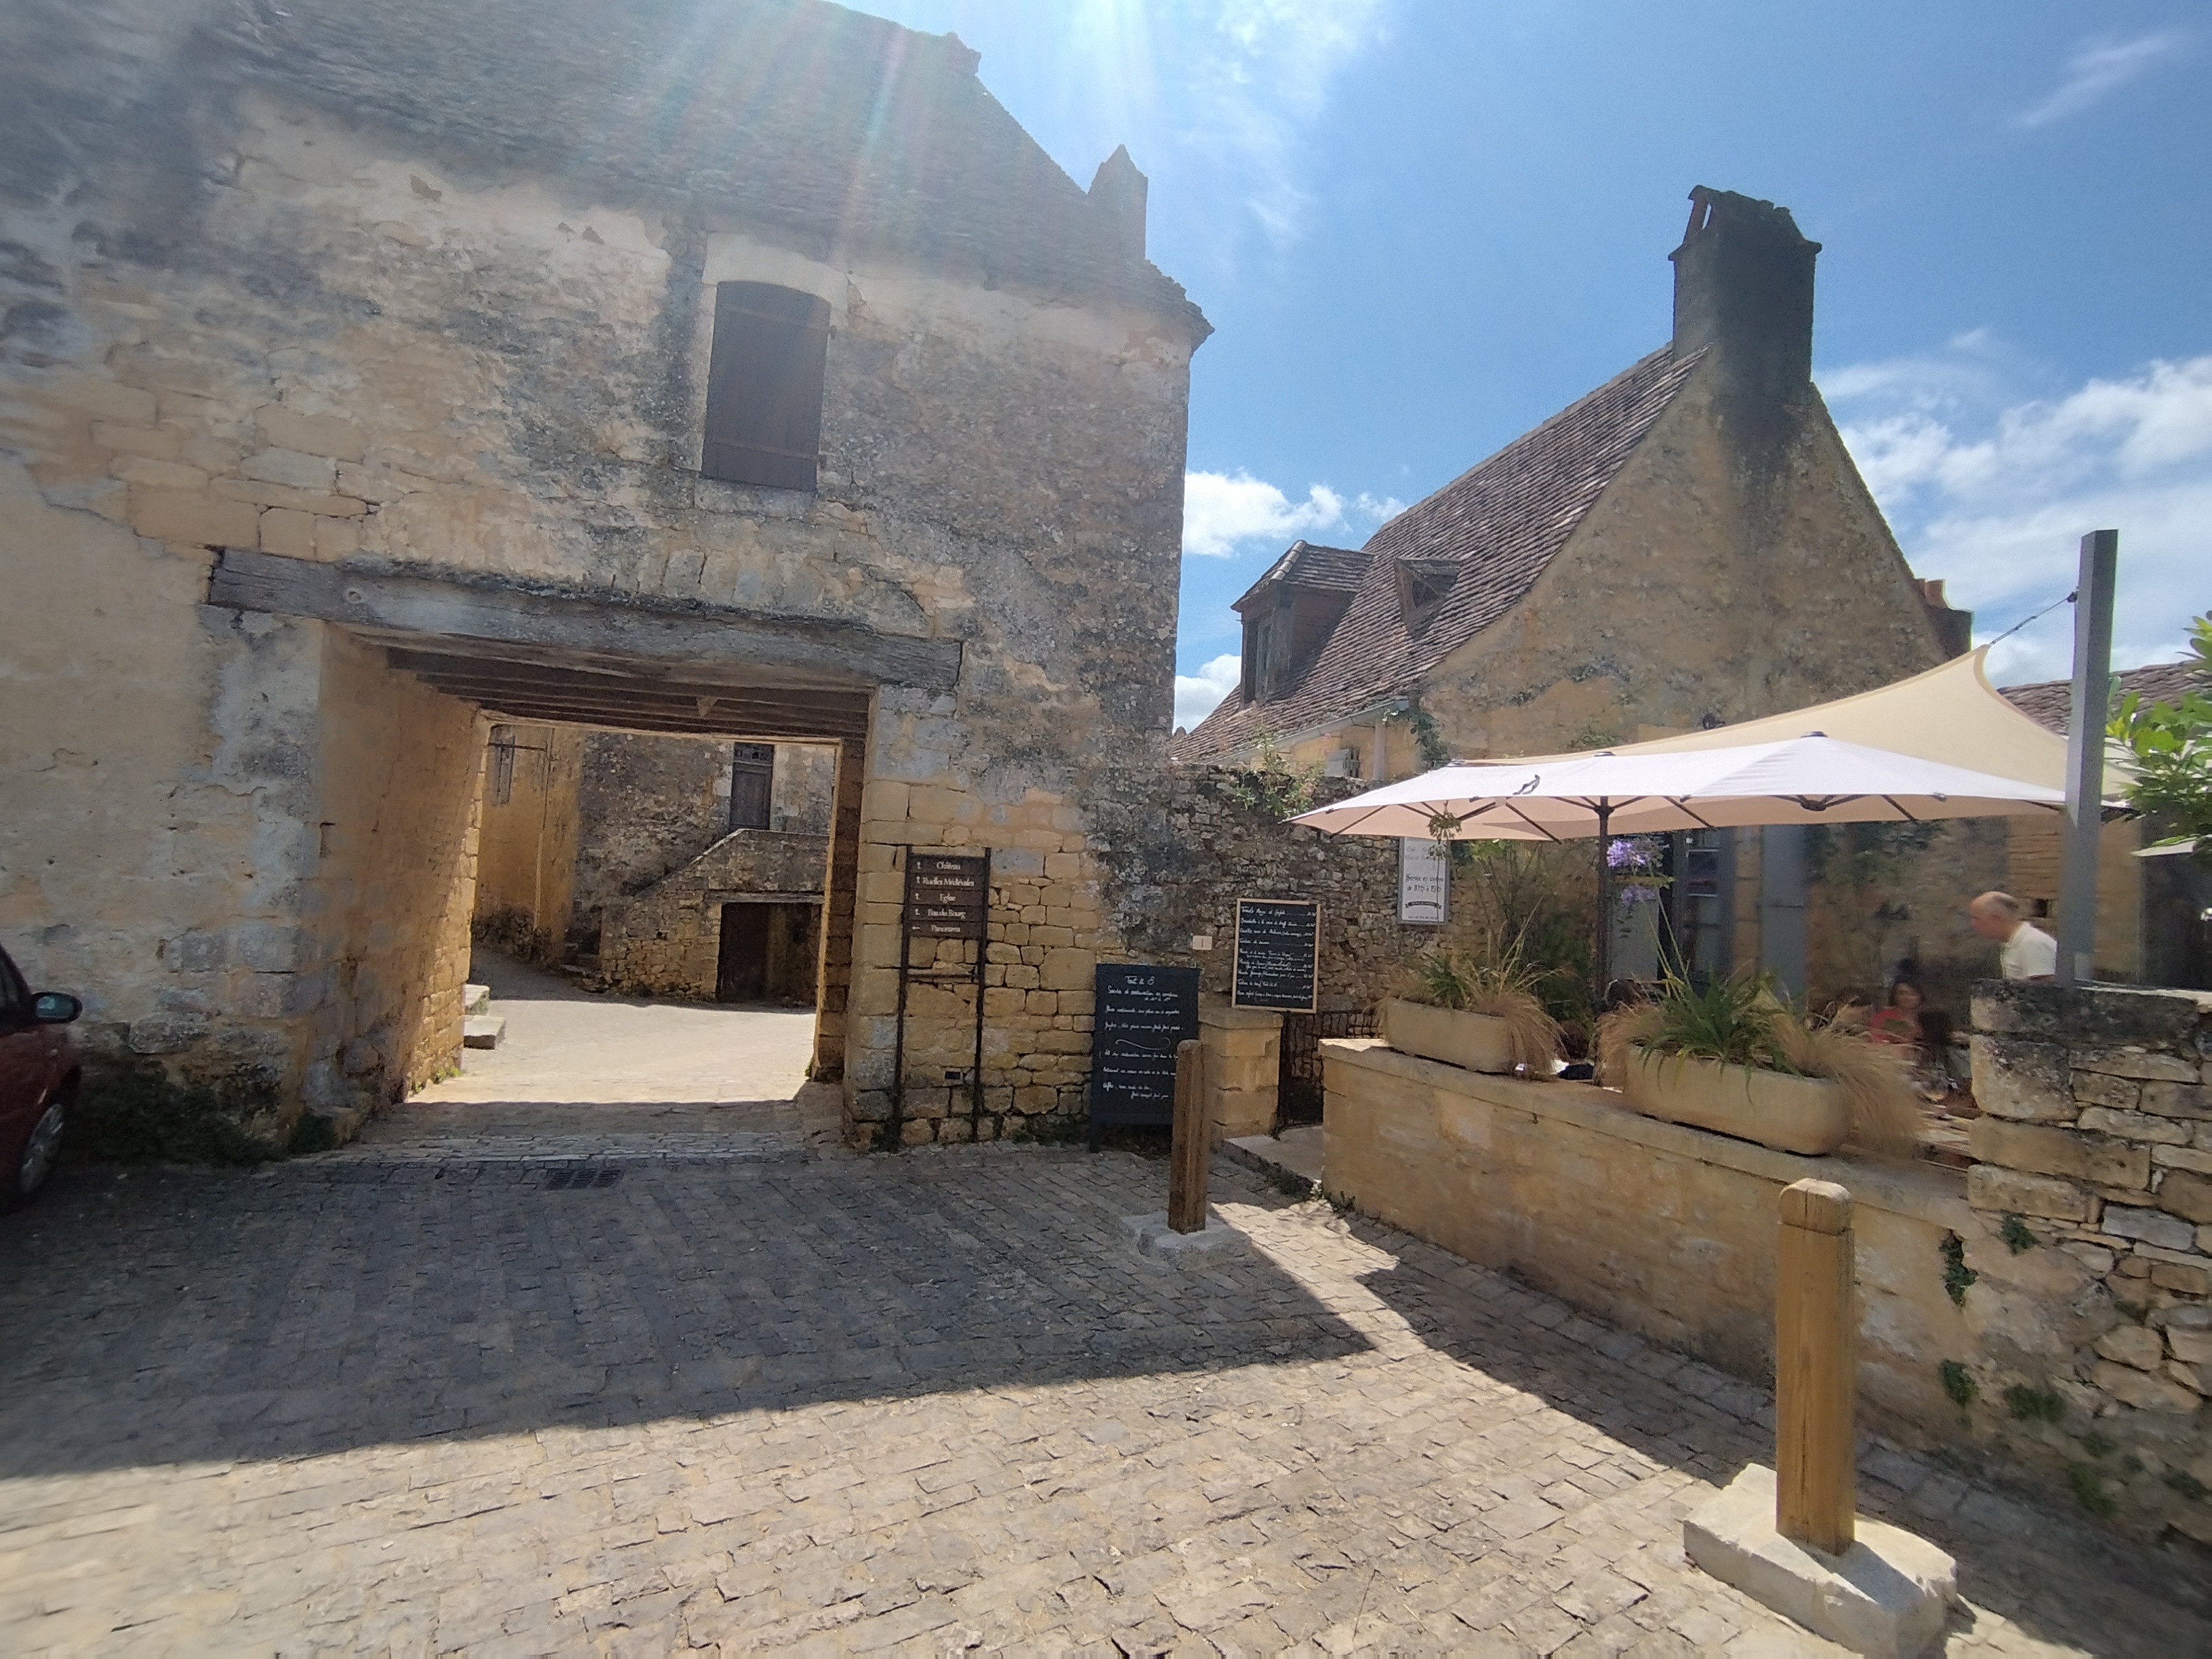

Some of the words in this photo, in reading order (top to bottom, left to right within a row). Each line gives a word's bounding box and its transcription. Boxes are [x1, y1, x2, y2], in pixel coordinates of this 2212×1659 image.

[936, 861, 961, 870] Château
[948, 909, 966, 920] Bourg
[931, 924, 961, 933] Panorama
